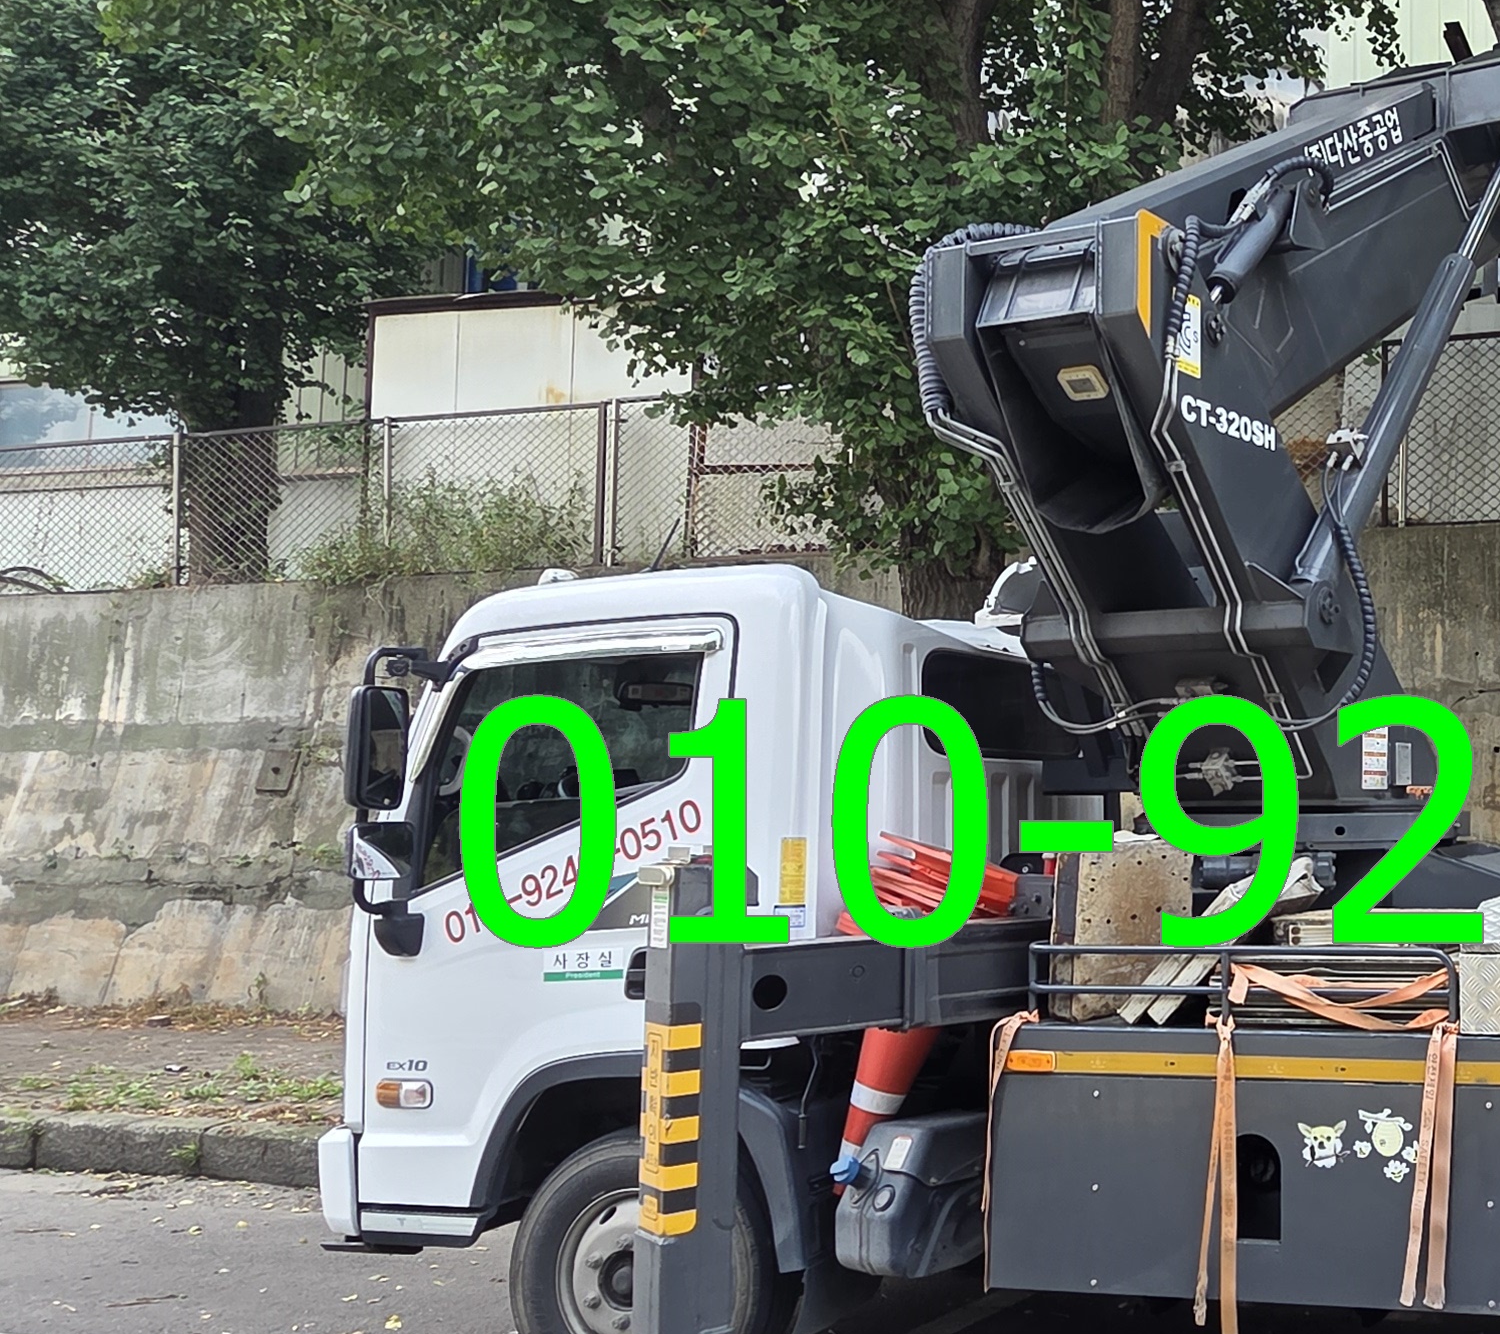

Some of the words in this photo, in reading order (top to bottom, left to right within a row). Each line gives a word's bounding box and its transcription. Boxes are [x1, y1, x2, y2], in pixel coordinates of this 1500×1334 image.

[1180, 394, 1276, 452] CT-320SH
[444, 799, 701, 943] 01-924-0510
[553, 951, 612, 969] 사장실
